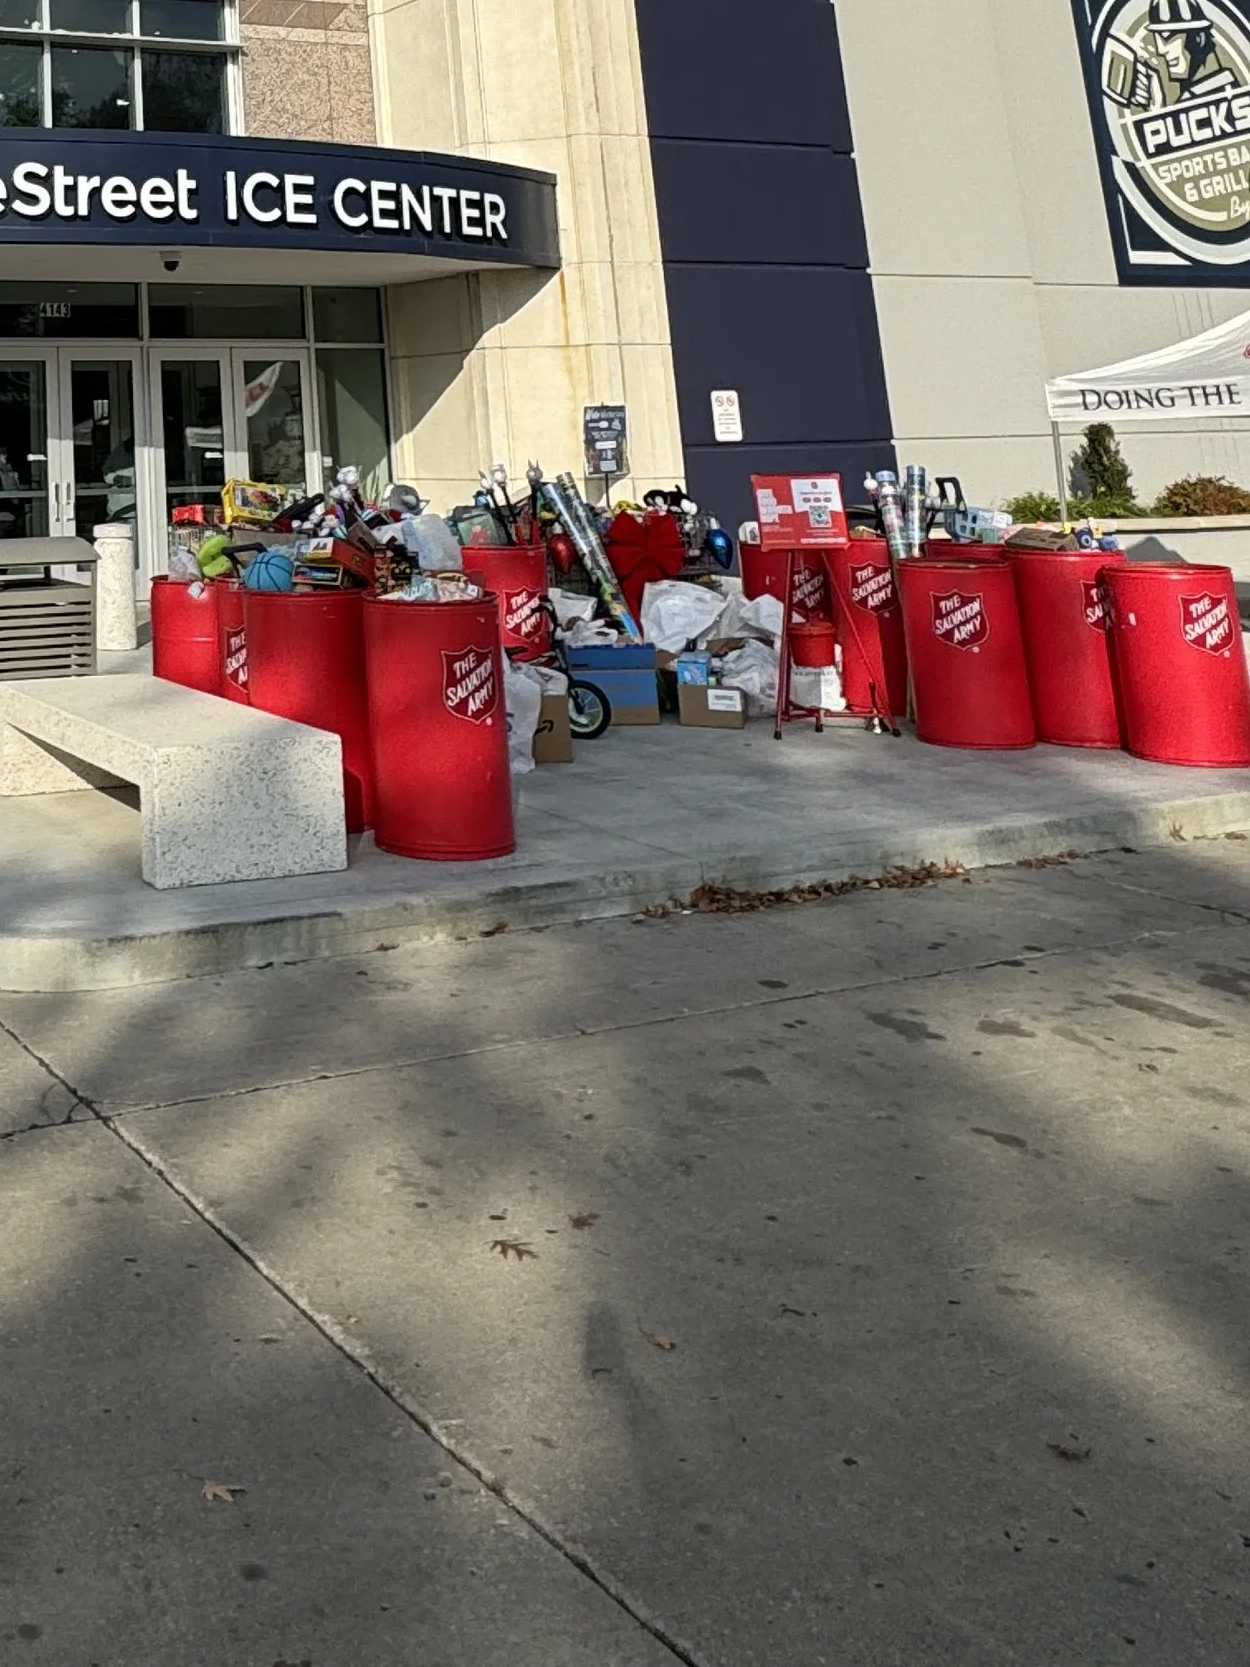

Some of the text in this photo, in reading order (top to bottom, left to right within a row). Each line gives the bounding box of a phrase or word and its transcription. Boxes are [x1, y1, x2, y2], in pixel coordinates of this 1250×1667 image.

[1143, 95, 1250, 154] PUCKS
[1158, 145, 1250, 184] SPORTS BA
[1199, 169, 1250, 199] GRILL
[226, 172, 318, 226] ICE
[335, 178, 509, 240] CENTER
[1079, 383, 1243, 411] DOING THE
[855, 566, 874, 583] THE
[935, 598, 981, 635] SALVATION
[939, 595, 961, 614] THE
[1184, 598, 1227, 640] SALVATION
[1189, 596, 1211, 618] THE
[953, 615, 982, 644] ARMY
[1206, 617, 1229, 649] ARMY
[447, 653, 492, 706] SALVATION
[453, 653, 477, 679] THE
[468, 676, 493, 716] ARMY
